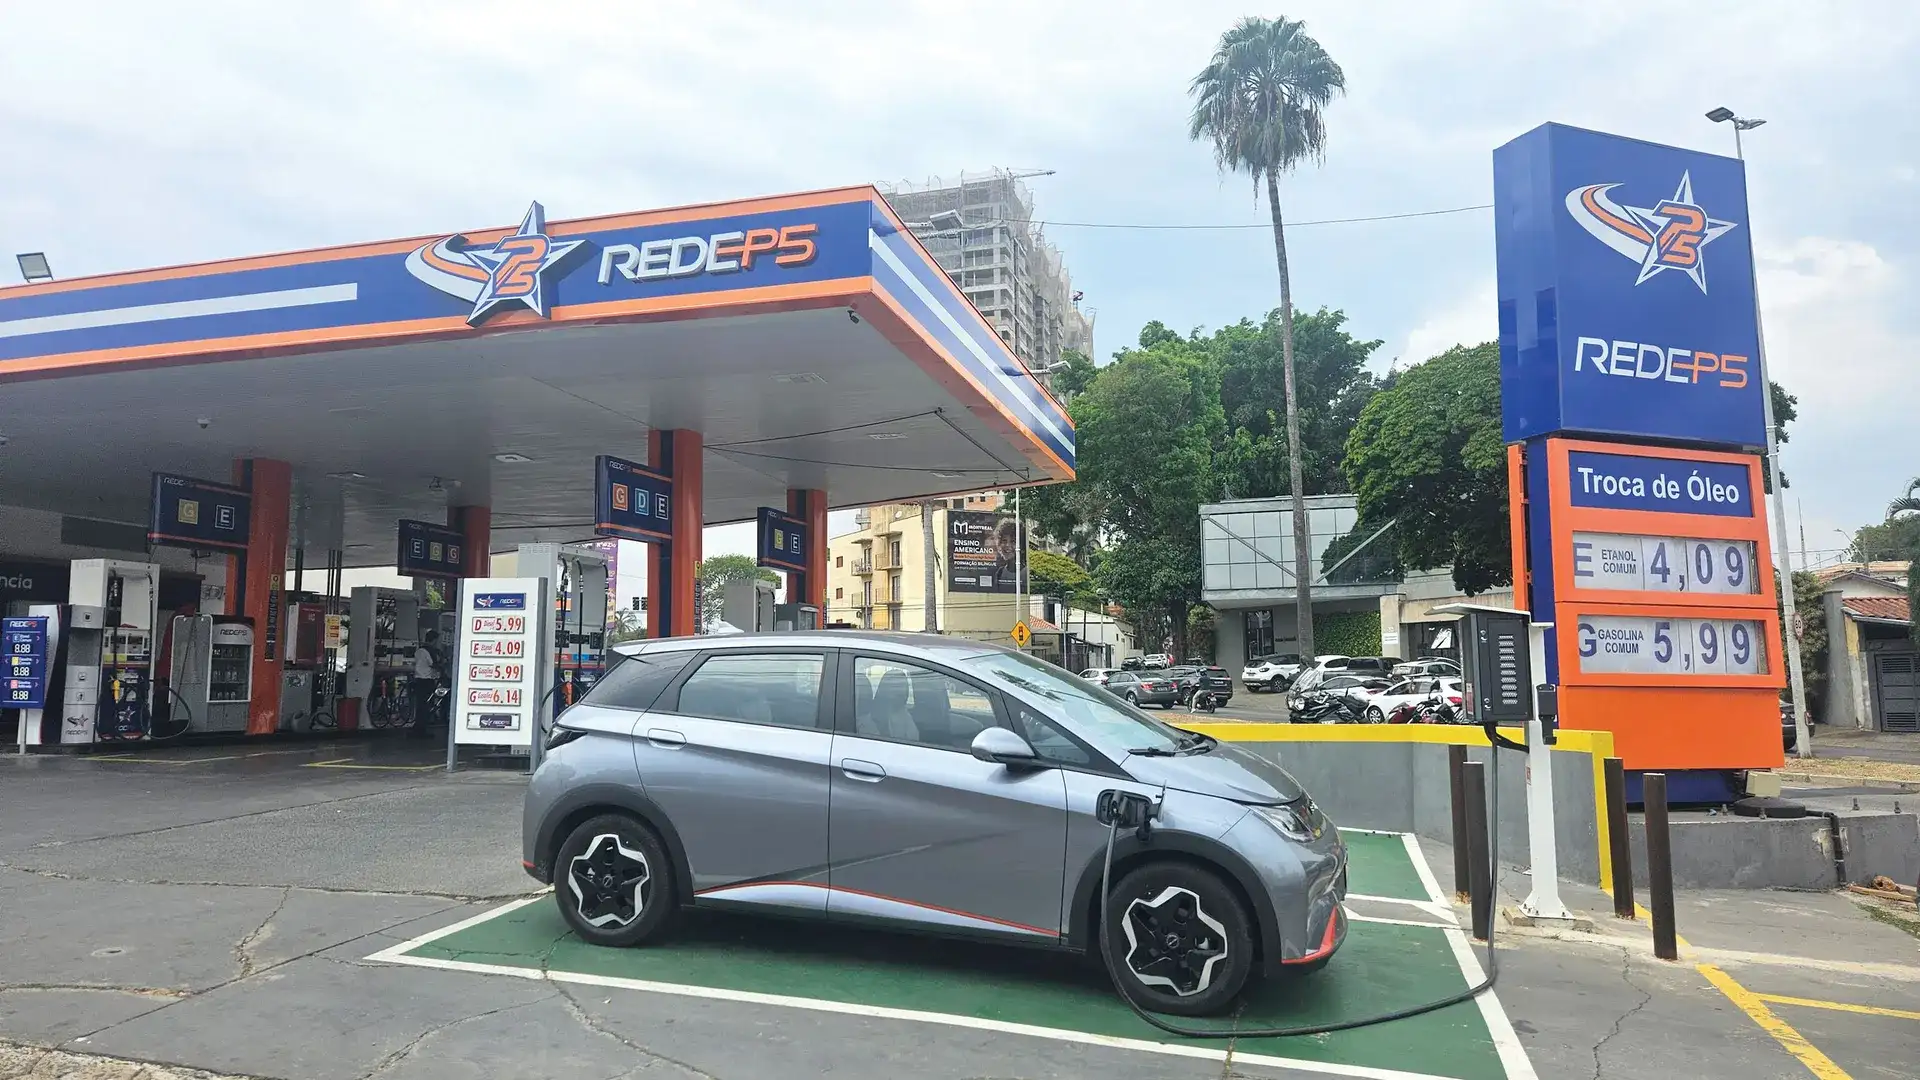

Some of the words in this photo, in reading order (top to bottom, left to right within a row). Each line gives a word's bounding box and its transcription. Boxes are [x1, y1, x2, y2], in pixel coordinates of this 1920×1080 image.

[1577, 467, 1645, 498] Troca
[1652, 473, 1680, 500] de
[1687, 470, 1740, 504] Óleo
[616, 487, 625, 504] G
[638, 492, 646, 508] D
[658, 497, 665, 513] E
[220, 508, 230, 524] E
[792, 536, 798, 549] E
[414, 542, 421, 553] E
[450, 548, 456, 558] G
[1601, 549, 1637, 562] ETANOL
[1572, 542, 1594, 577] E
[1603, 562, 1637, 575] COMUM
[474, 619, 482, 630] D
[496, 618, 522, 631] 5.99
[1577, 623, 1598, 658] G
[1598, 629, 1644, 642] GASOLINA
[474, 643, 479, 654] E
[496, 642, 520, 654] 4.09
[1605, 642, 1639, 654] COMUM
[471, 666, 478, 678] G
[494, 666, 520, 679] 5.99
[470, 691, 477, 702] G
[494, 690, 518, 704] 6.14
